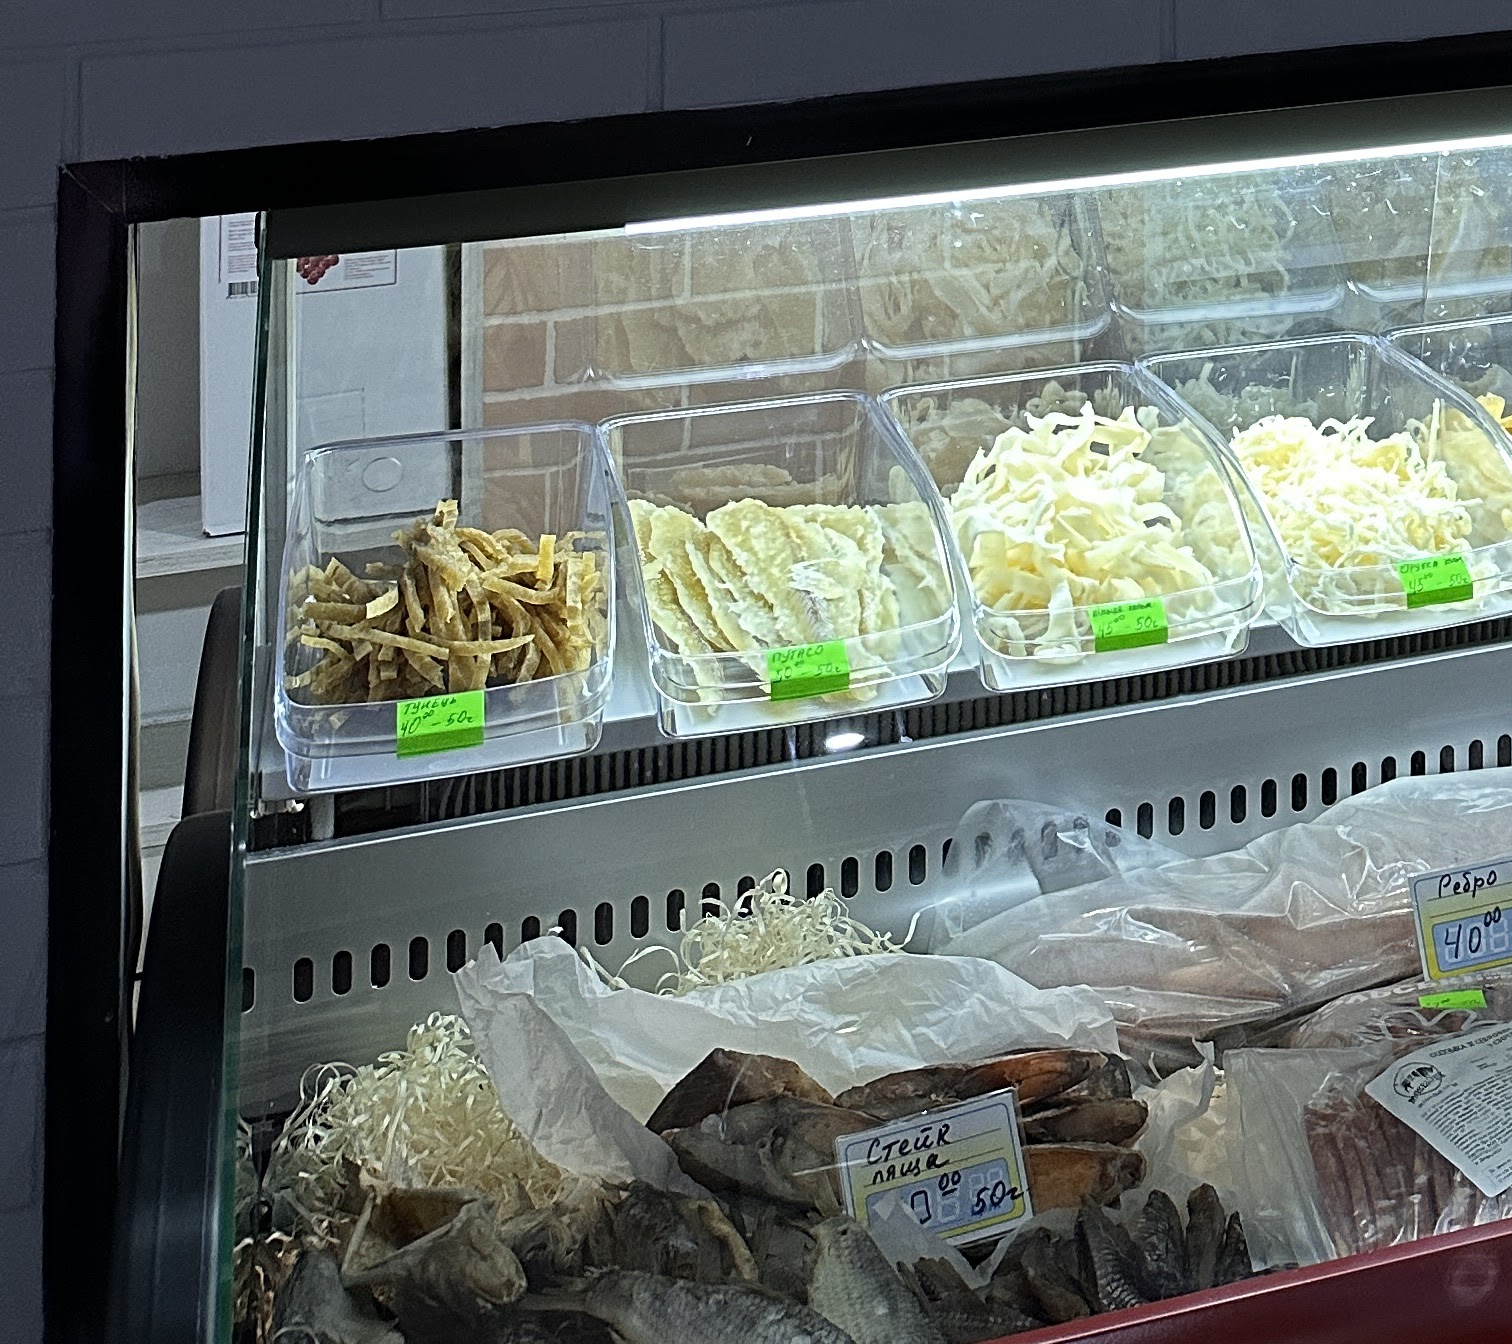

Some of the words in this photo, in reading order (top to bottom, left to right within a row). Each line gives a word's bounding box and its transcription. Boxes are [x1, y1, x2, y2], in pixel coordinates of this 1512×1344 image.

[1438, 870, 1497, 899] Ребро
[867, 1123, 951, 1165] Стейк
[872, 1153, 951, 1186] ляща
